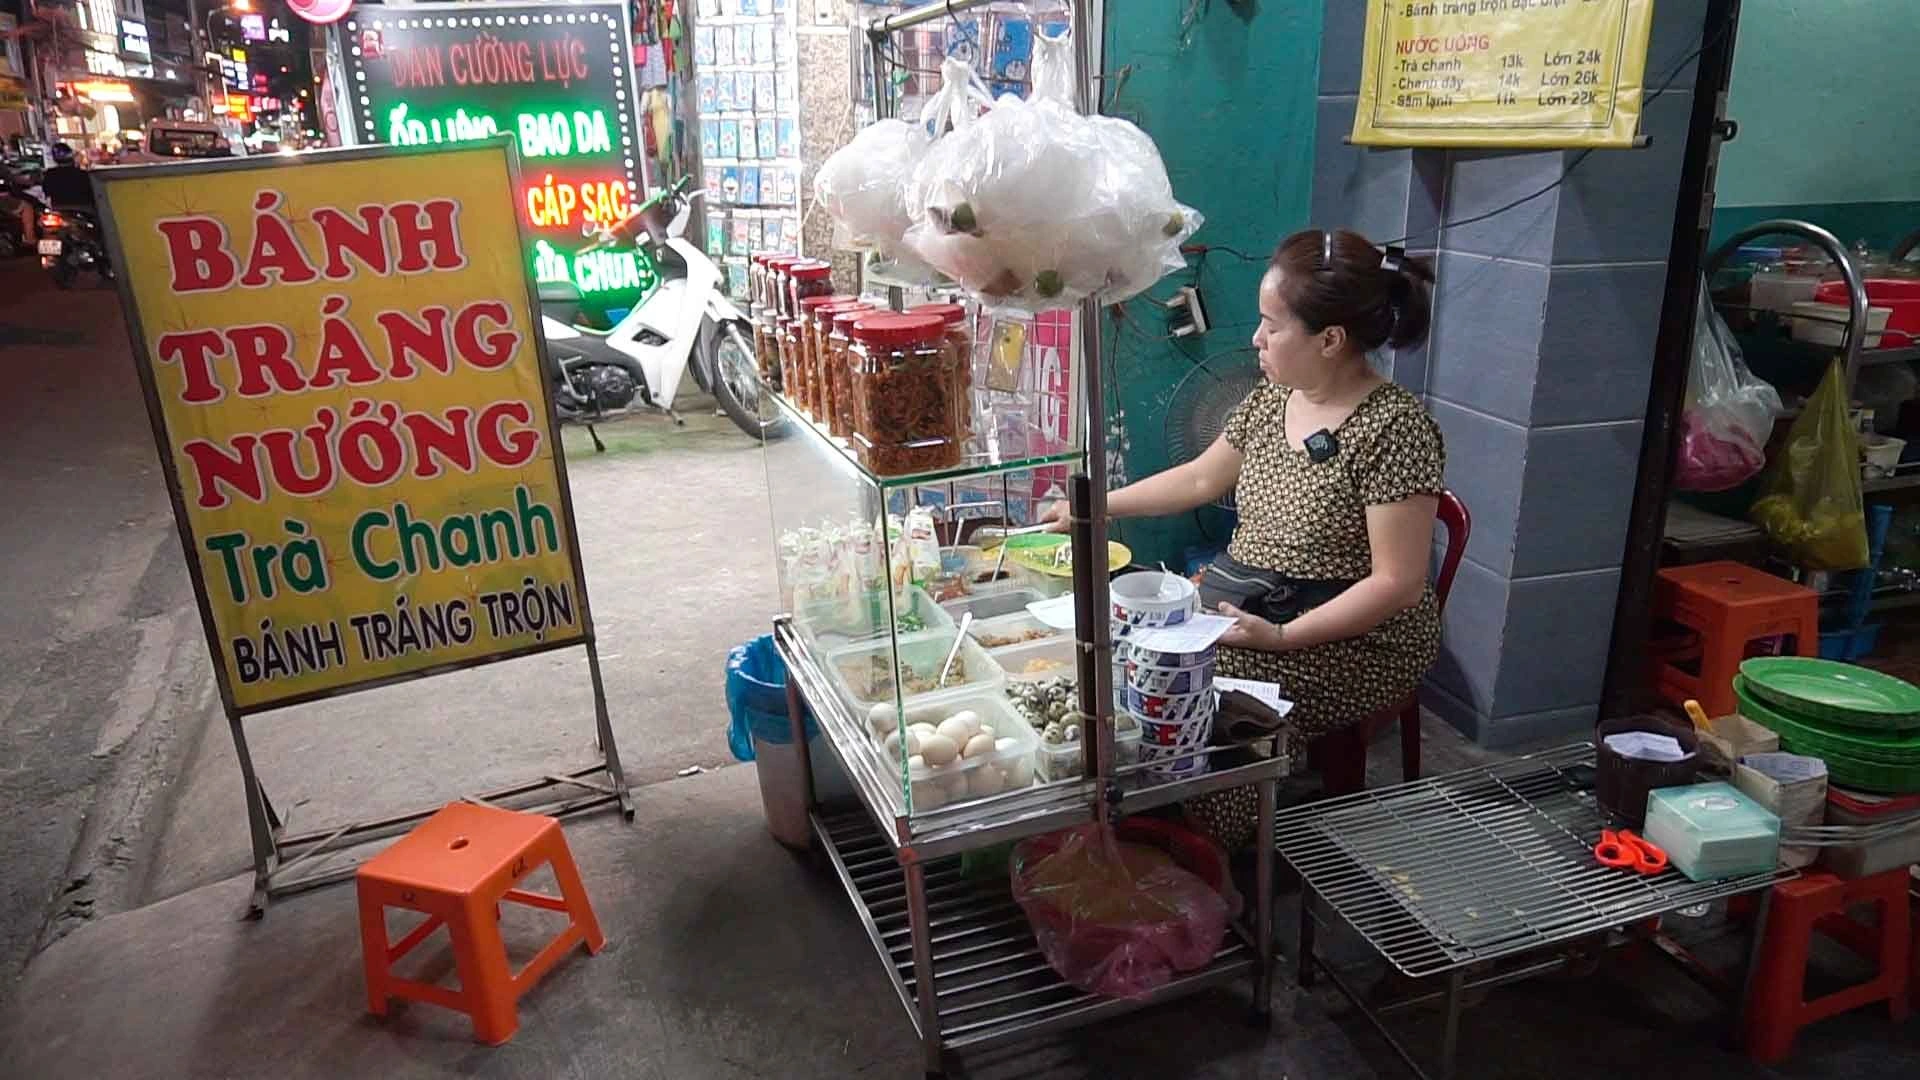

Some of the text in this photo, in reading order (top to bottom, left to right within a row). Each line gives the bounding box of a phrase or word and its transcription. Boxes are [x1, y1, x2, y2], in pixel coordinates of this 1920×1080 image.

[1422, 58, 1461, 71] chanh
[1576, 50, 1601, 65] 24k
[1574, 69, 1599, 84] 26k
[517, 112, 571, 157] BAO
[573, 110, 611, 154] DA
[156, 191, 465, 293] BÁNH
[527, 174, 576, 227] CÁP
[157, 297, 518, 402] TRÁNG
[183, 400, 540, 507] NƯỚNG
[206, 486, 559, 603] Trà Chanh
[233, 577, 574, 683] BÁNH TRÁNG TRỘN
